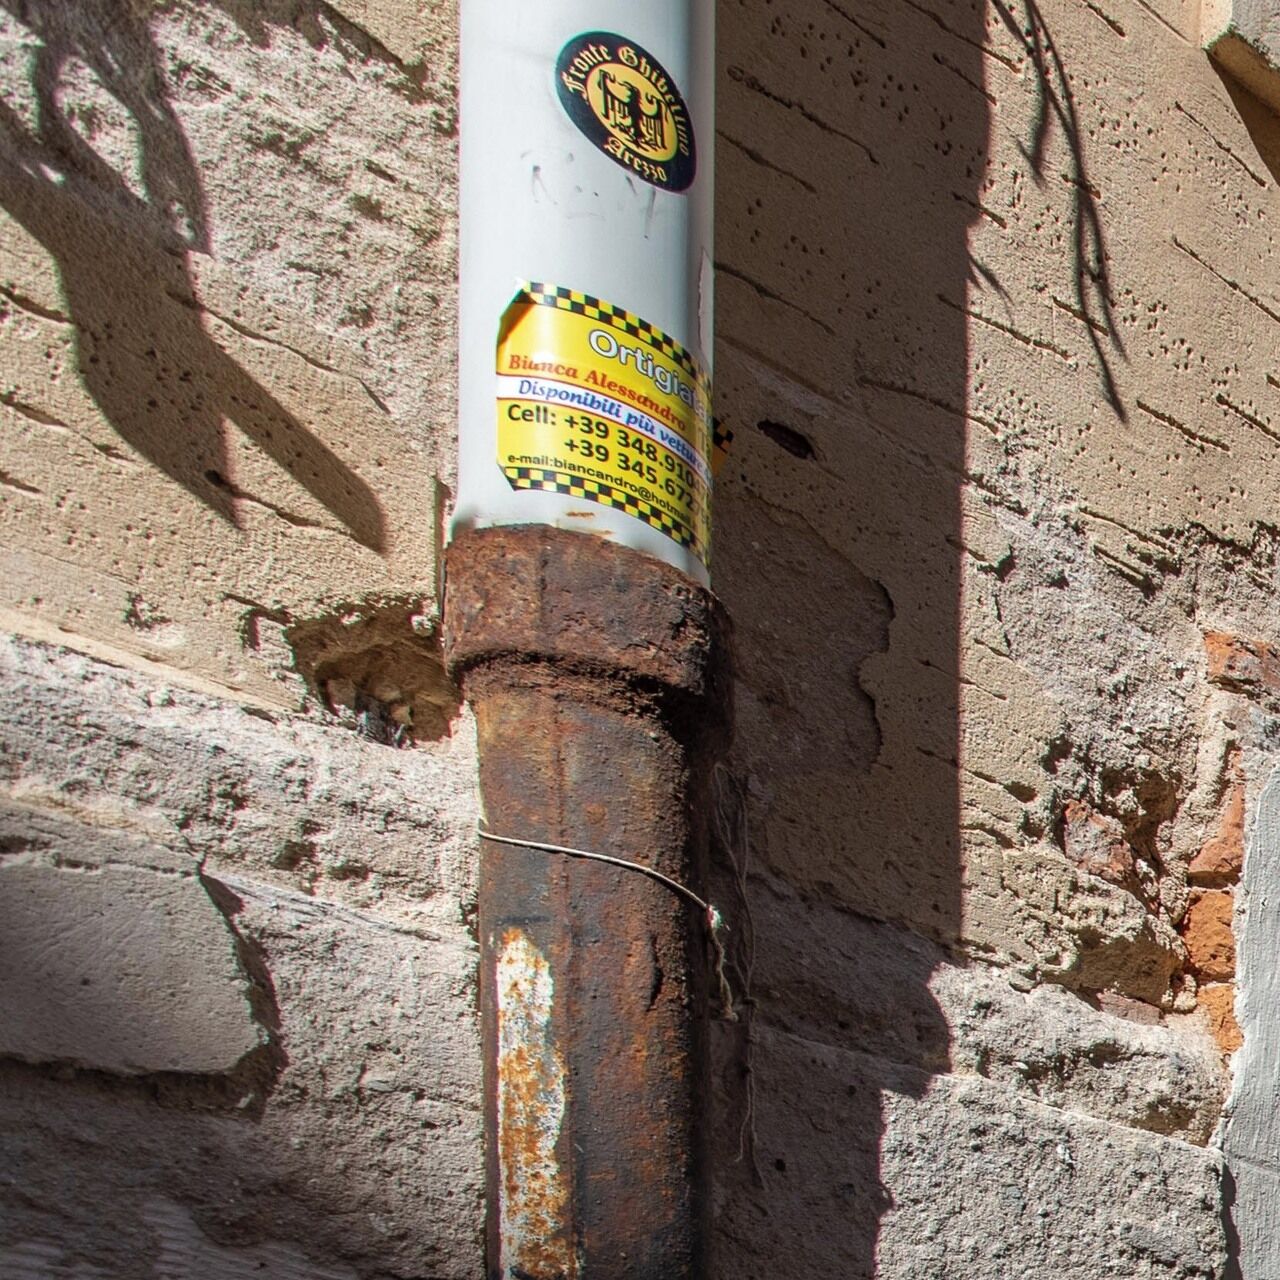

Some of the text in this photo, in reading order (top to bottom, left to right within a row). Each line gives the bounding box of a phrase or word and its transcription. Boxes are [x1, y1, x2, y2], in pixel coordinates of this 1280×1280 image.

[561, 43, 613, 97] Fronte
[508, 354, 686, 432] Bianca Alessandro
[518, 380, 622, 418] Disponibili
[626, 412, 656, 435] più
[507, 404, 557, 426] Cell:
[564, 415, 610, 440] +39
[564, 439, 700, 513] +39 345.672
